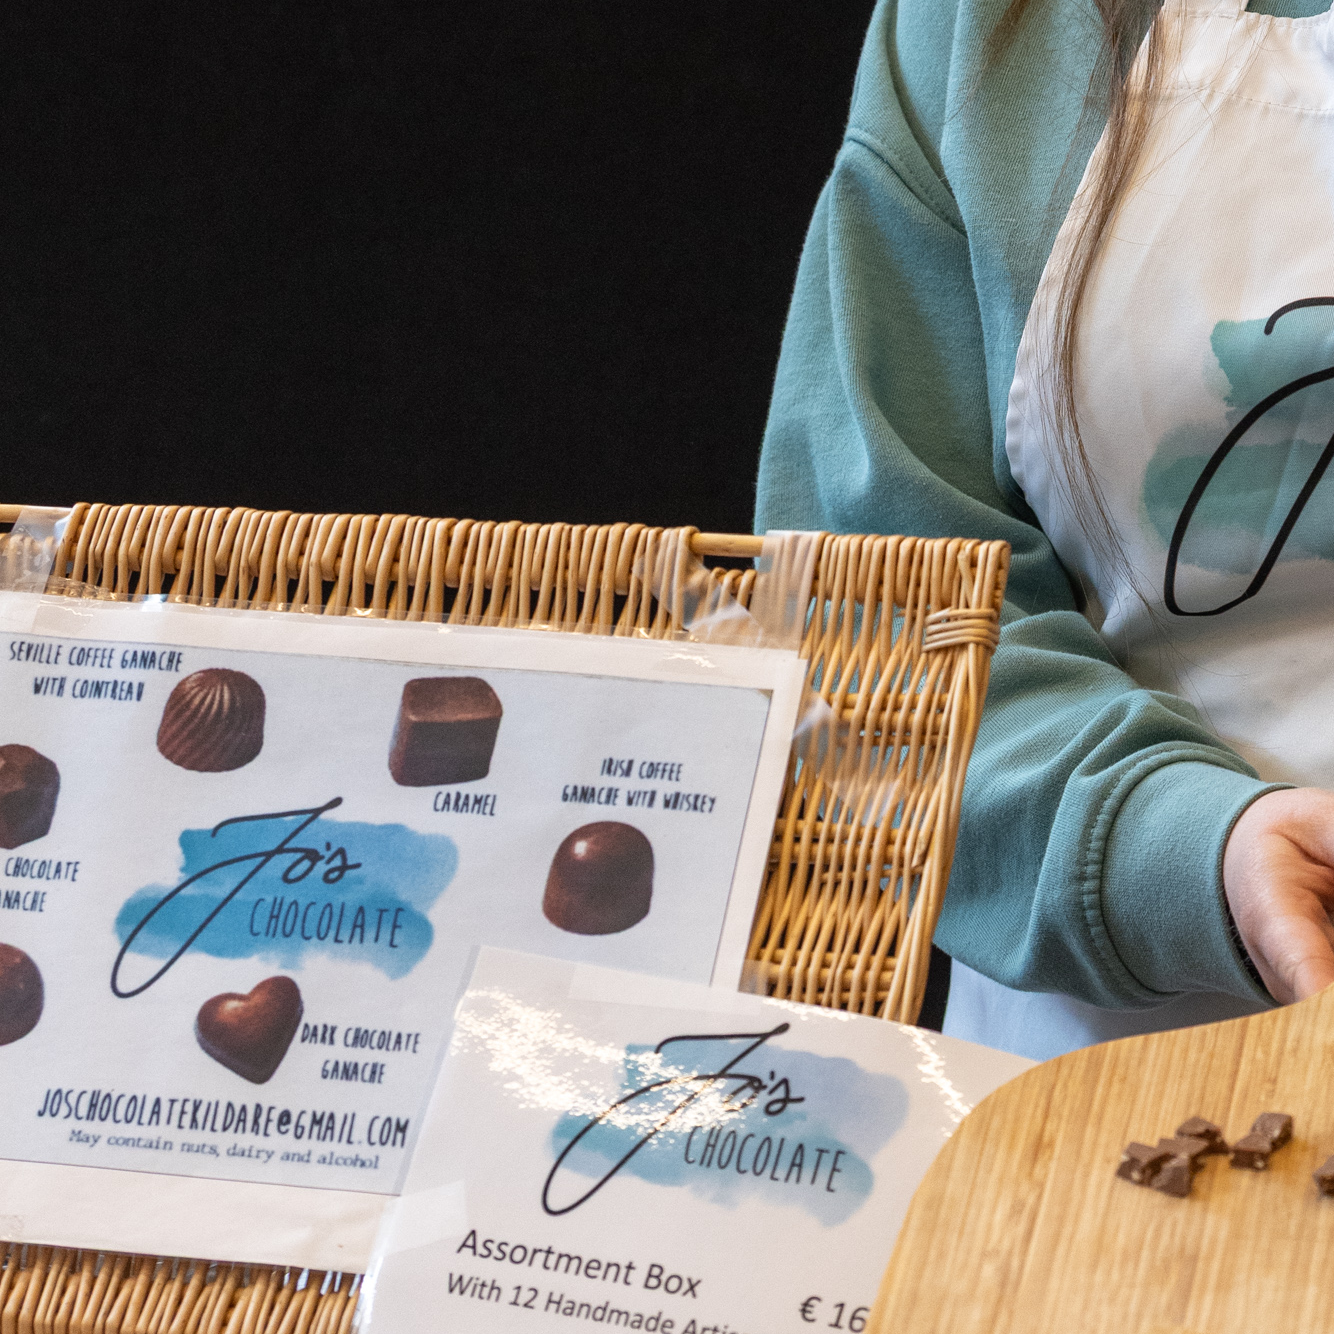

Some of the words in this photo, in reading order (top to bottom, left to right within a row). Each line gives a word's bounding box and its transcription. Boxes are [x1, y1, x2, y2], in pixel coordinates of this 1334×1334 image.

[10, 640, 63, 665] SEVILLE
[68, 646, 115, 669] COFFEE
[120, 649, 183, 673] GANACHE
[33, 676, 67, 698] WITH
[71, 678, 145, 702] COINTREAU
[601, 756, 634, 778] IRISH
[638, 761, 683, 782] COFFEE
[433, 791, 497, 817] CARAMEL
[561, 784, 619, 807] GANACHE
[626, 789, 657, 809] WITH
[663, 791, 717, 814] WHISKEY
[4, 856, 81, 883] CHOCOLATE
[0, 890, 47, 913] NACHE
[111, 796, 362, 998] Jo's
[249, 898, 405, 948] CHOCOLATE
[300, 1022, 338, 1046] DARK
[343, 1026, 420, 1054] CHOCOLATE
[321, 1059, 386, 1084] GANACHE
[37, 1088, 409, 1148] JOSCHOCOLATEKILDARE@GMAIL.COM
[69, 1129, 101, 1148] May
[107, 1135, 173, 1151] contain
[180, 1141, 220, 1157] nuts,
[226, 1143, 274, 1164] dairy
[280, 1150, 311, 1164] and
[316, 1154, 380, 1169] alcohol
[684, 1124, 847, 1193] CHOCOLATE
[456, 1229, 636, 1286] Assortment
[643, 1263, 702, 1299] Box
[447, 1272, 503, 1303] With
[508, 1284, 539, 1310] 12
[798, 1296, 822, 1323] €
[828, 1302, 870, 1334] 16
